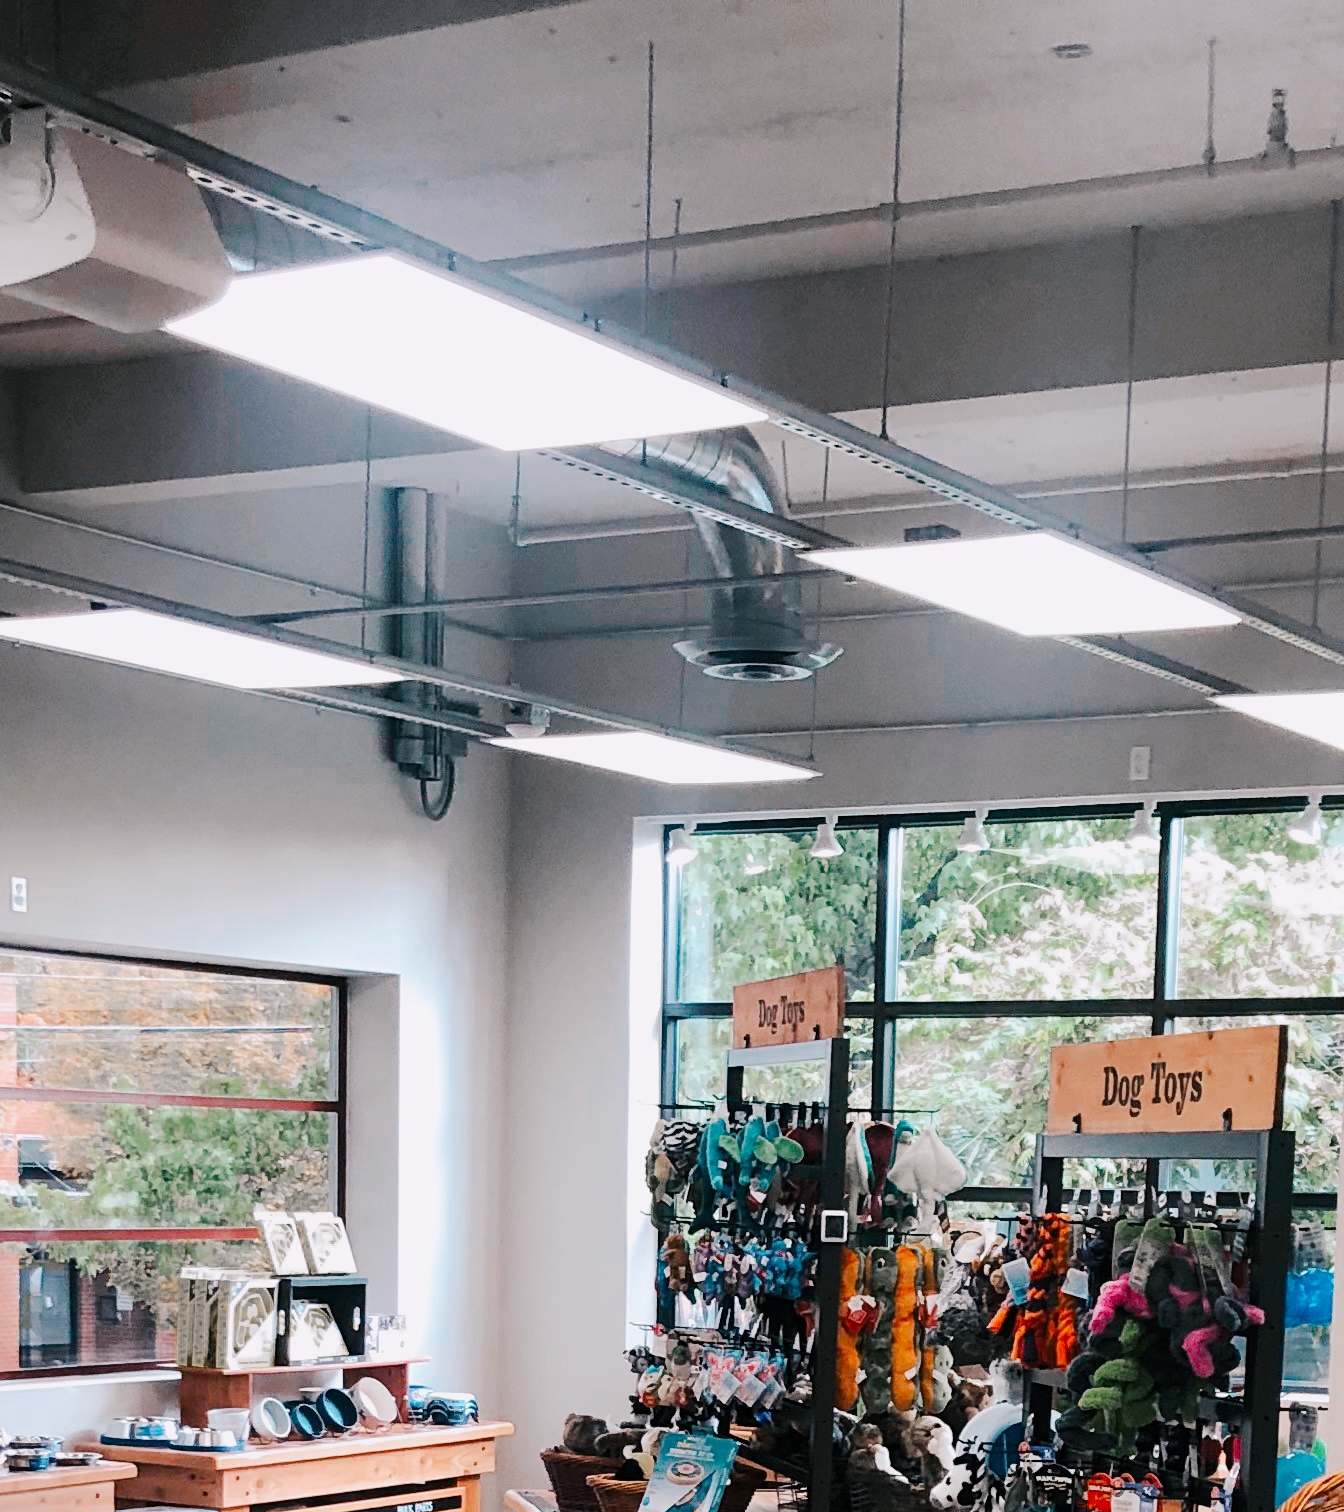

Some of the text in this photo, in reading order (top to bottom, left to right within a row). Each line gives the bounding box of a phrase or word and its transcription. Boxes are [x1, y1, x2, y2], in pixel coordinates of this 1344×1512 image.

[758, 995, 805, 1035] Dog Toys
[1102, 1062, 1203, 1117] Dog Toys
